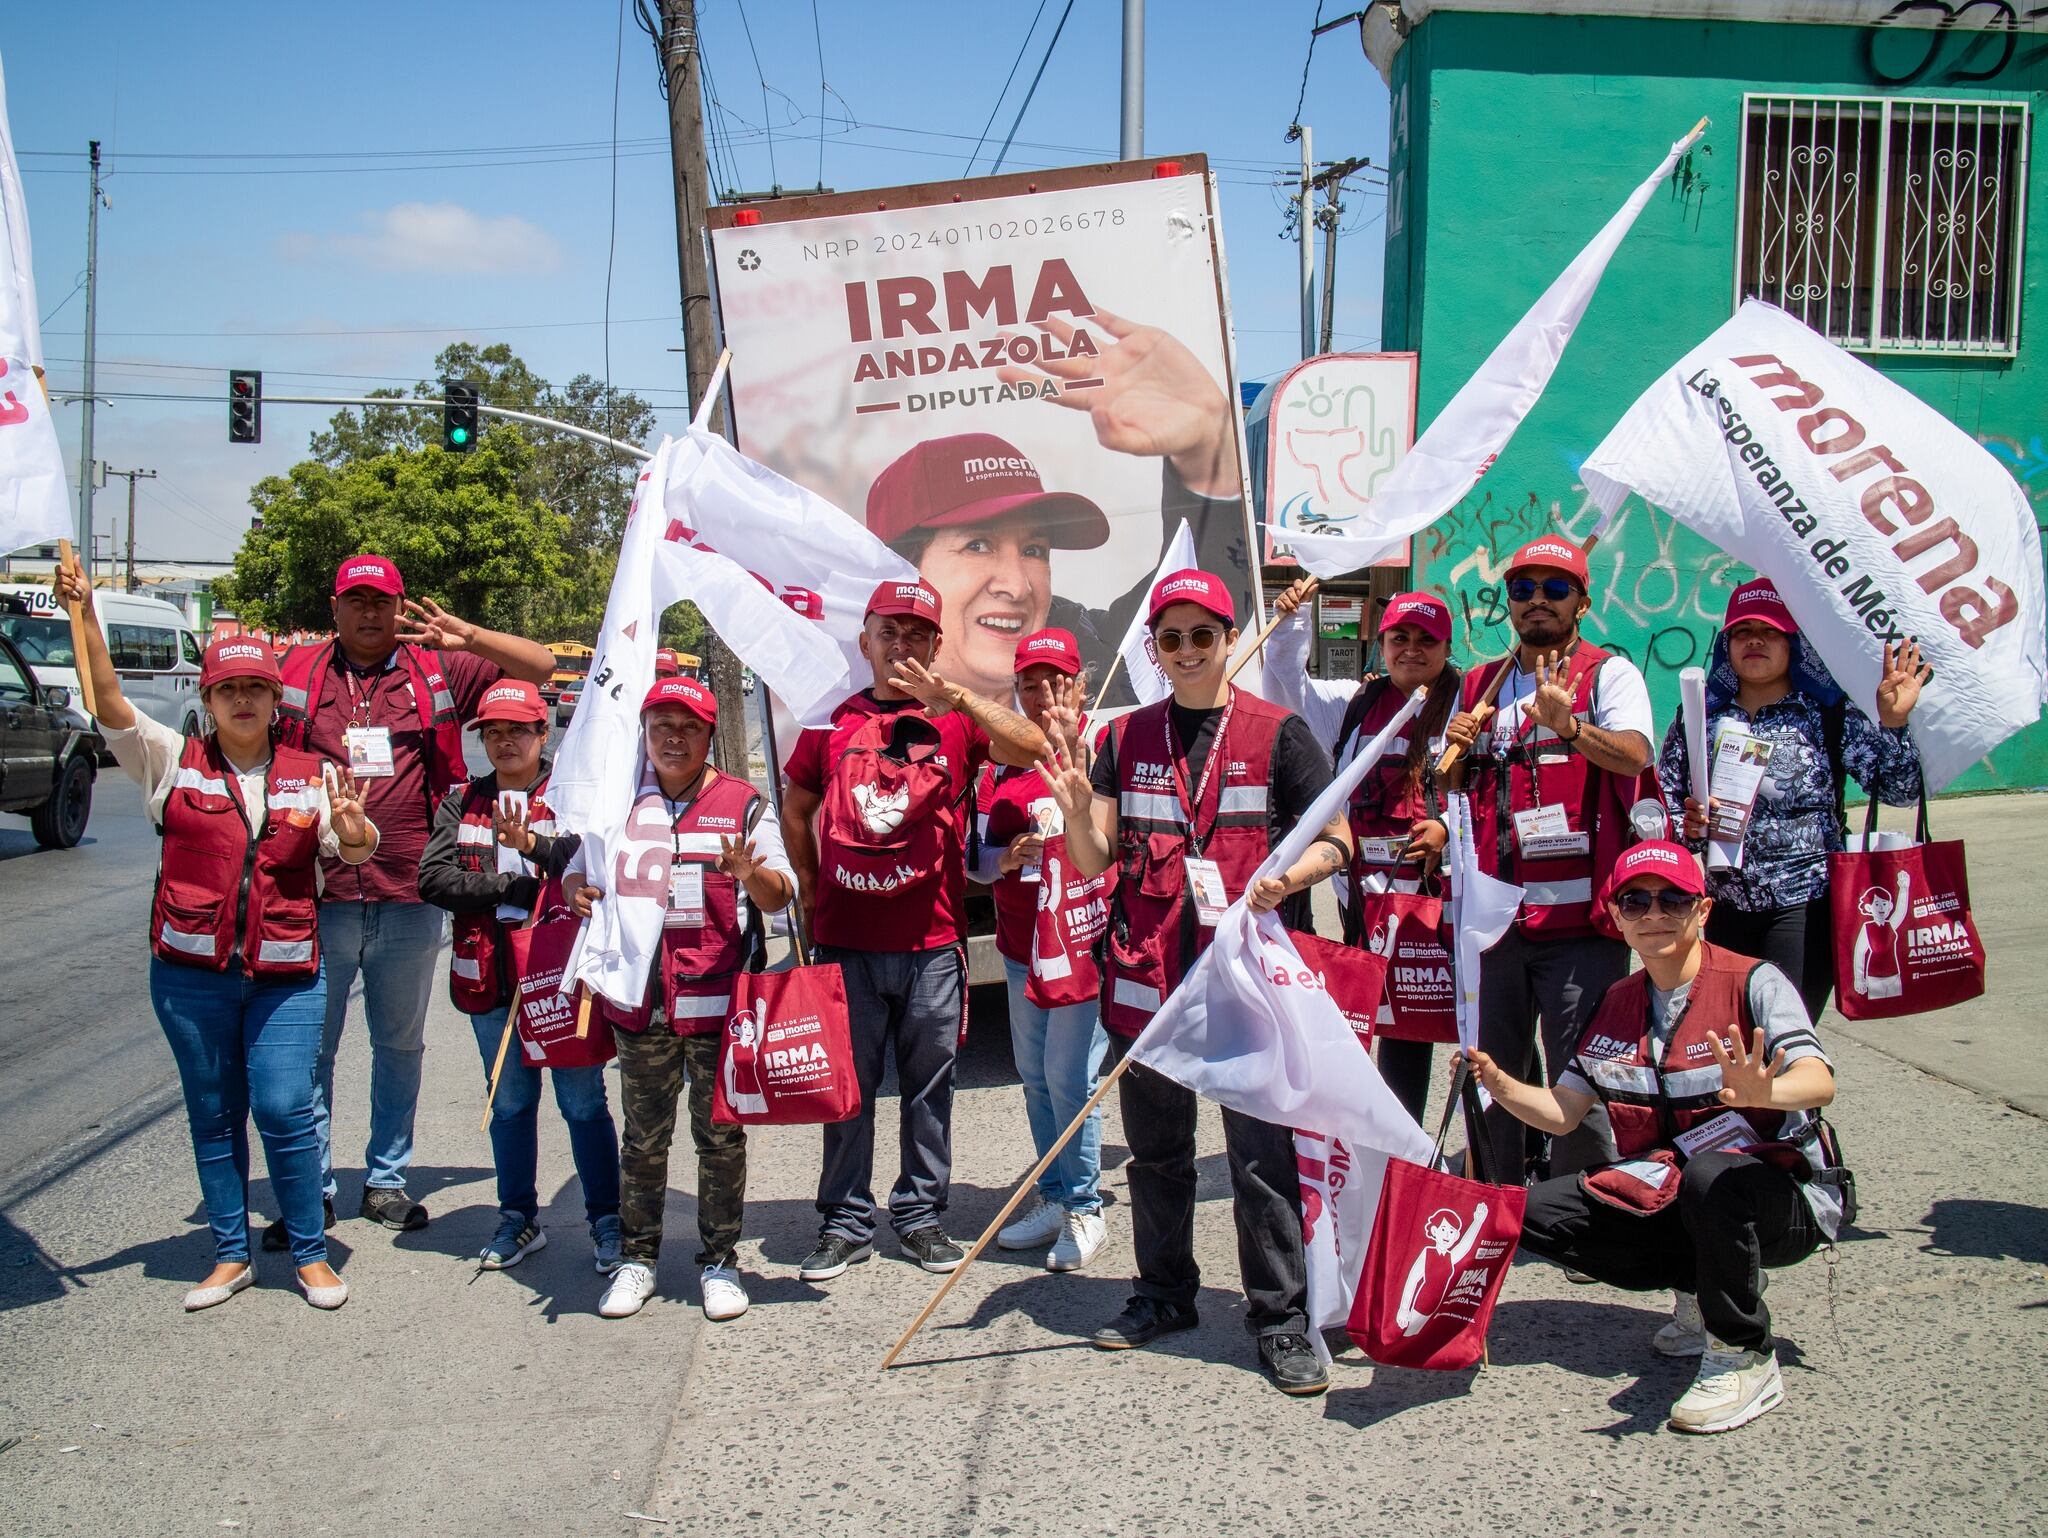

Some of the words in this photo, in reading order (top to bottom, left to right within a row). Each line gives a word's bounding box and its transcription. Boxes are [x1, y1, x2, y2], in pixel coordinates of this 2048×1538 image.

[803, 238, 859, 262] NRP
[874, 208, 1126, 255] 202401102026678
[843, 257, 1097, 344] IRMA
[852, 328, 1101, 384] ANDAZOLA
[906, 379, 1060, 415] DIPUTADA
[963, 456, 1036, 475] moren
[1686, 368, 1721, 399] La
[1719, 396, 1818, 540] esperanza
[1810, 537, 1850, 579] de
[965, 475, 974, 483] La
[976, 470, 1013, 481] esperanza
[1015, 469, 1024, 477] de
[1728, 353, 2020, 651] morena
[1526, 543, 1573, 559] morena
[348, 564, 385, 575] morena
[1161, 578, 1209, 594] morena
[16, 589, 61, 610] 709
[896, 585, 936, 605] morena
[1398, 600, 1437, 616] morena
[218, 643, 263, 658] morena
[1028, 637, 1066, 649] morena
[1330, 648, 1355, 657] TAROT
[486, 686, 526, 700] morena
[661, 683, 703, 700] morena
[1213, 715, 1229, 751] morena
[1722, 742, 1741, 752] IRMA
[1134, 761, 1174, 777] RMA
[697, 815, 737, 826] morena
[1626, 848, 1679, 865] morena
[1065, 896, 1108, 927] IRMA
[1927, 898, 1960, 912] morena
[1907, 920, 1969, 948] IRMA
[1415, 948, 1448, 956] morena
[1908, 939, 1971, 958] ANDAZOLA
[1921, 952, 1964, 965] DIPUTADA
[534, 972, 564, 987] morena
[1394, 966, 1453, 984] IRMA
[1395, 984, 1454, 993] ANDAZOLA
[1407, 993, 1445, 1001] DIPUTADA
[523, 992, 571, 1019] IRMA
[530, 1009, 572, 1028] ANDAZOLA
[799, 1015, 818, 1023] JUNIO
[1351, 1012, 1370, 1021] JUNIO
[785, 1021, 822, 1036] morena
[1590, 1034, 1638, 1054] IRMA
[763, 1042, 829, 1070] IRMA
[1585, 1045, 1635, 1061] ANDAZOLA
[767, 1060, 830, 1079] ANDAZOLA
[781, 1073, 821, 1085] DIPUTADA
[1705, 1116, 1730, 1131] VOTAR?
[1456, 1267, 1489, 1287] IRMA
